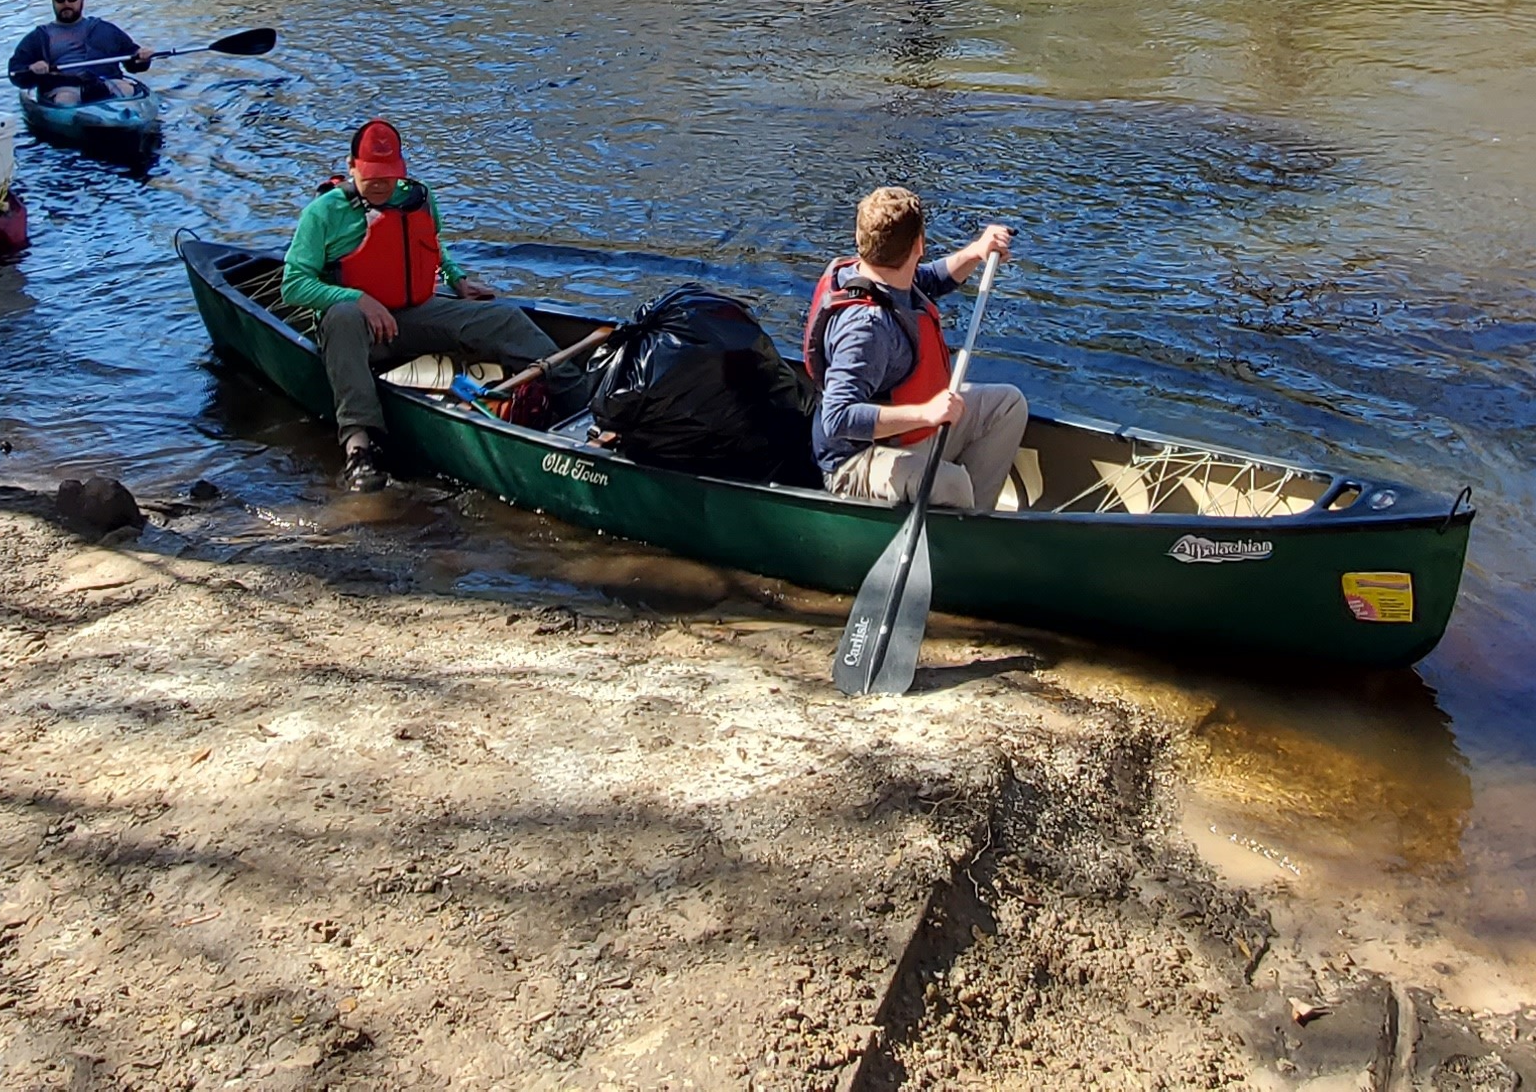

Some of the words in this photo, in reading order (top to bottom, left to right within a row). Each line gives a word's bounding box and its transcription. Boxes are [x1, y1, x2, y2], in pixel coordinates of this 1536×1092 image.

[542, 452, 570, 477] Old
[571, 458, 609, 487] Town
[843, 616, 870, 666] Carlisle
